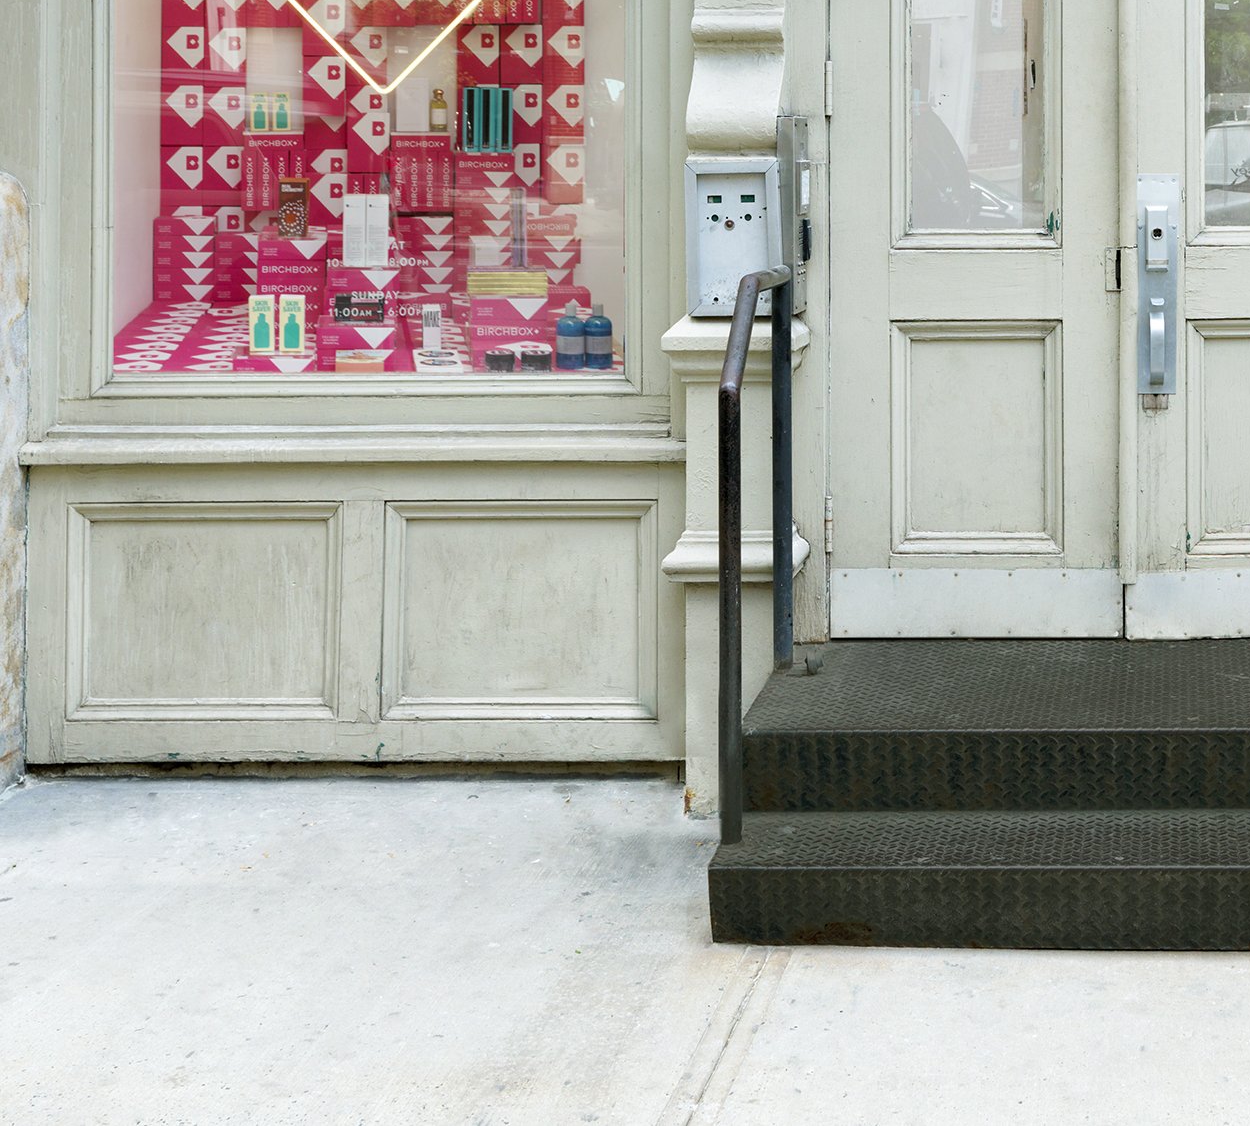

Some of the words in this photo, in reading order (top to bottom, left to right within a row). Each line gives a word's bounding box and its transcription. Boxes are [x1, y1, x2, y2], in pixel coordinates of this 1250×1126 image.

[248, 139, 293, 147] BIRCHBOX
[395, 140, 440, 148] BIRCHBOX
[458, 160, 503, 168] BIRCHBOX
[262, 162, 270, 207] BIRCHBOX
[426, 162, 434, 207] BIRCHBOX
[442, 162, 450, 207] BIRCHBOX
[261, 265, 314, 274] BIRCHBOX
[260, 284, 313, 293] BIRCHBOX
[351, 290, 400, 300] SUNDAY
[328, 307, 373, 317] 11:00AM
[476, 326, 534, 337] BIRCHBOX
